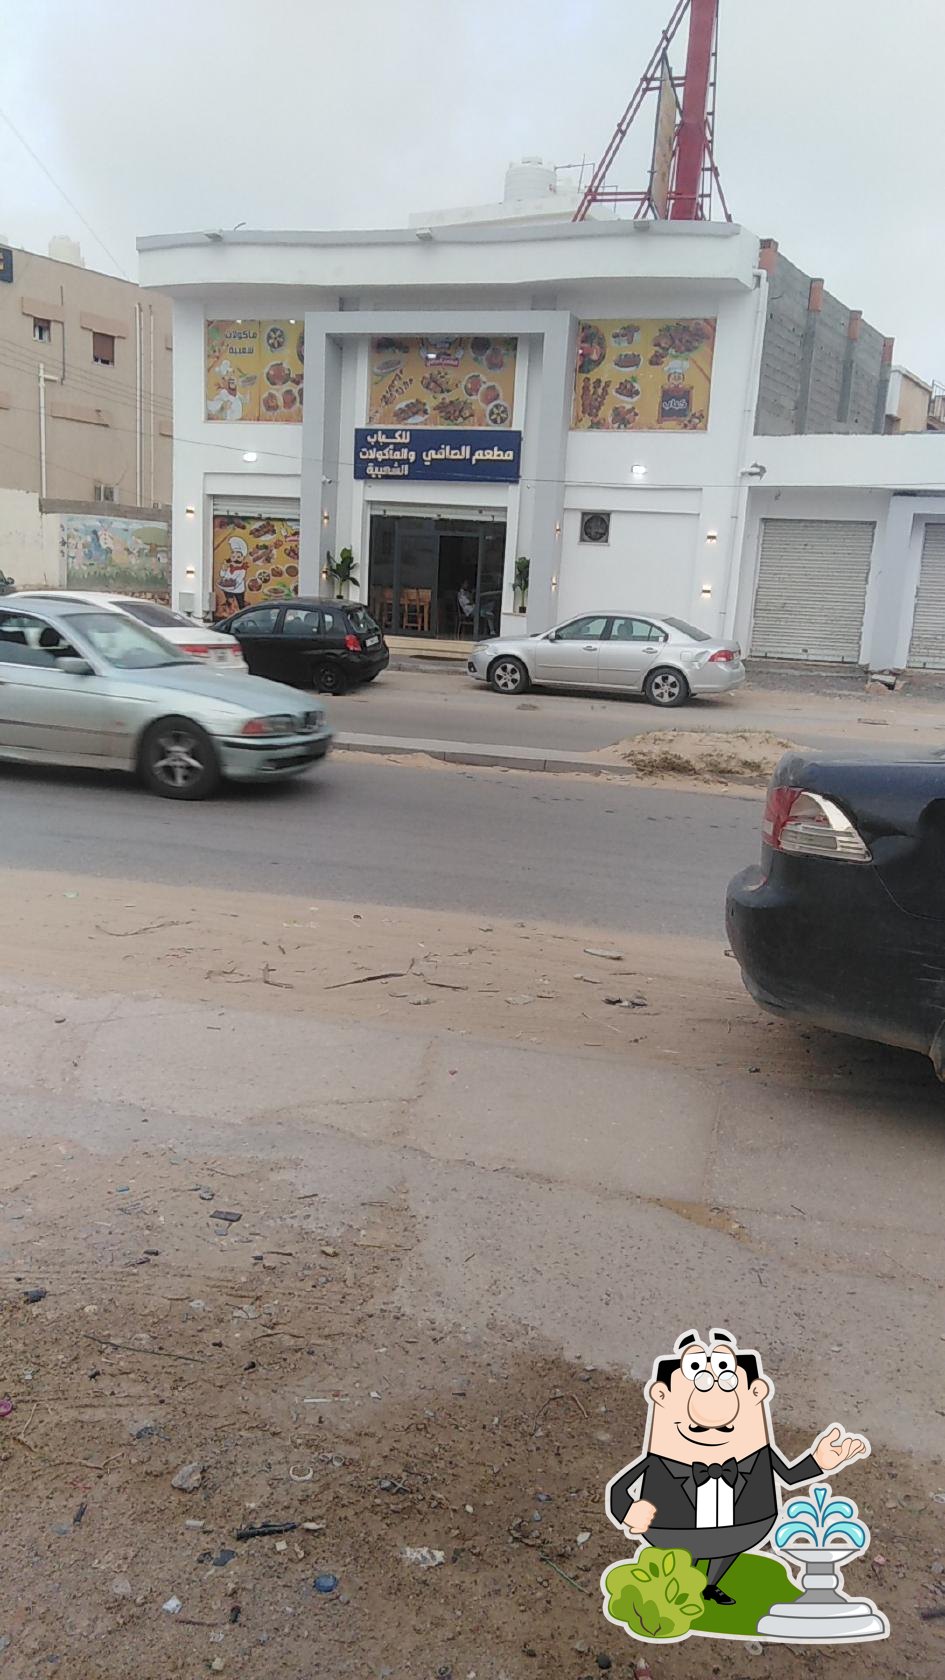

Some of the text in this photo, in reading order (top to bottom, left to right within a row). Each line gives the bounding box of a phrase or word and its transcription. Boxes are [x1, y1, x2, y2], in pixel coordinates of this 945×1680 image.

[367, 430, 410, 445] للكباب
[422, 444, 514, 466] مطعم الصافي
[366, 461, 409, 478] الشعبية
